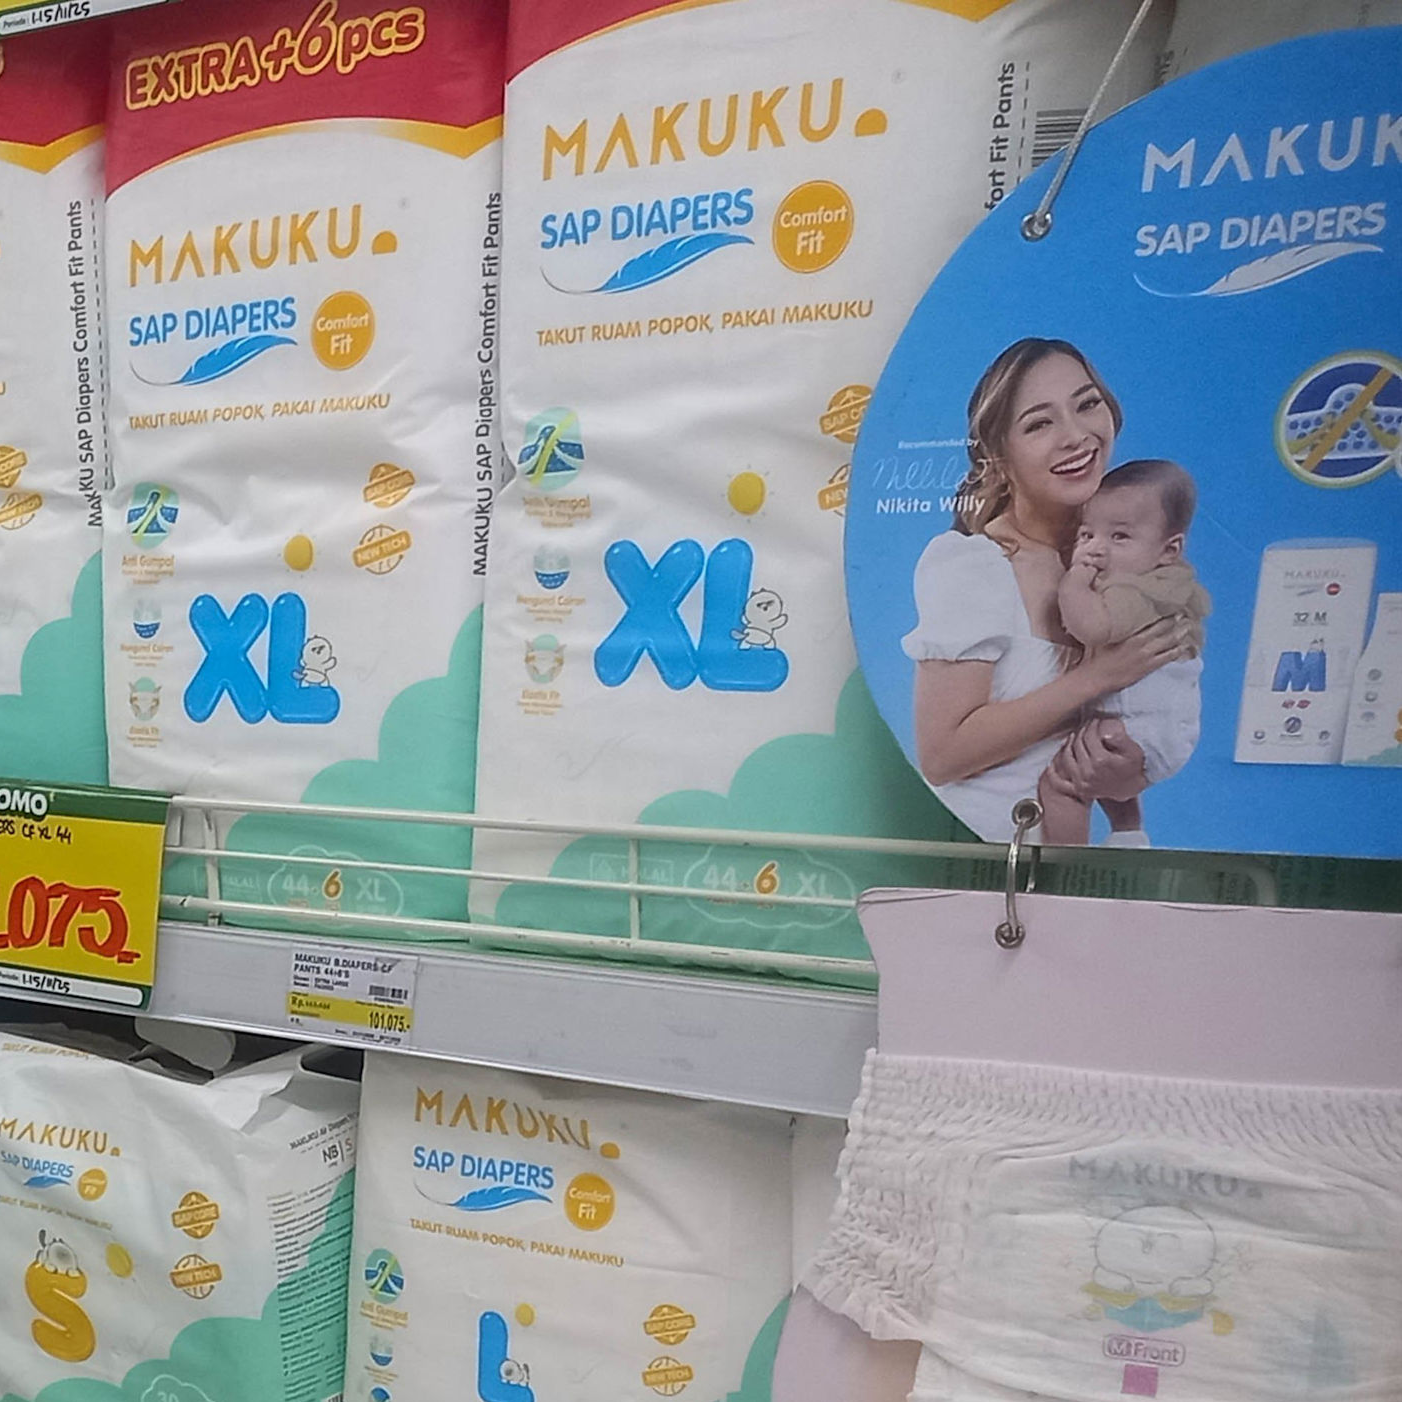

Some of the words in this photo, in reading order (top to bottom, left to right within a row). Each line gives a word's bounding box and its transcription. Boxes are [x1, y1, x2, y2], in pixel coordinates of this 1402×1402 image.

[997, 62, 1015, 131] Pants
[543, 77, 844, 181] MAKUKU
[991, 135, 1011, 168] Fit
[66, 200, 83, 251] Pants
[540, 209, 601, 250] SAP
[610, 188, 754, 242] DIAPERS
[780, 203, 847, 228] Comfort
[1135, 223, 1210, 258] SAP
[1221, 202, 1387, 252] DIAPERS
[129, 204, 362, 288] MAKUKU
[796, 229, 826, 256] Fit
[69, 255, 86, 277] Fit
[70, 281, 89, 353] Comfort
[128, 315, 177, 348] SAP
[186, 297, 297, 341] DIAPERS
[316, 312, 370, 333] Comfort
[537, 327, 586, 348] TAKUT
[592, 321, 641, 342] RUAM
[647, 315, 714, 337] POPOK,
[722, 308, 775, 329] PAKAI
[782, 300, 873, 325] MAKUKU
[330, 333, 352, 357] Fit
[72, 356, 93, 425] Diapers
[128, 414, 165, 431] TAKUT
[169, 409, 208, 428] RUAM
[272, 399, 316, 419] PAKAI
[320, 393, 391, 415] MAKUKU
[78, 428, 95, 464] SAP
[967, 437, 981, 450] by
[876, 497, 931, 515] Nikita
[938, 495, 986, 516] Willy
[594, 536, 790, 693] XL
[184, 592, 341, 725] XL
[1272, 651, 1327, 692] M
[38, 826, 53, 841] XL
[55, 827, 72, 845] 44
[416, 1086, 591, 1150] MAKUKU
[413, 1146, 454, 1175] SAP
[460, 1154, 555, 1190] DIAPERS
[25, 1261, 96, 1362] S
[1133, 1341, 1180, 1366] Front
